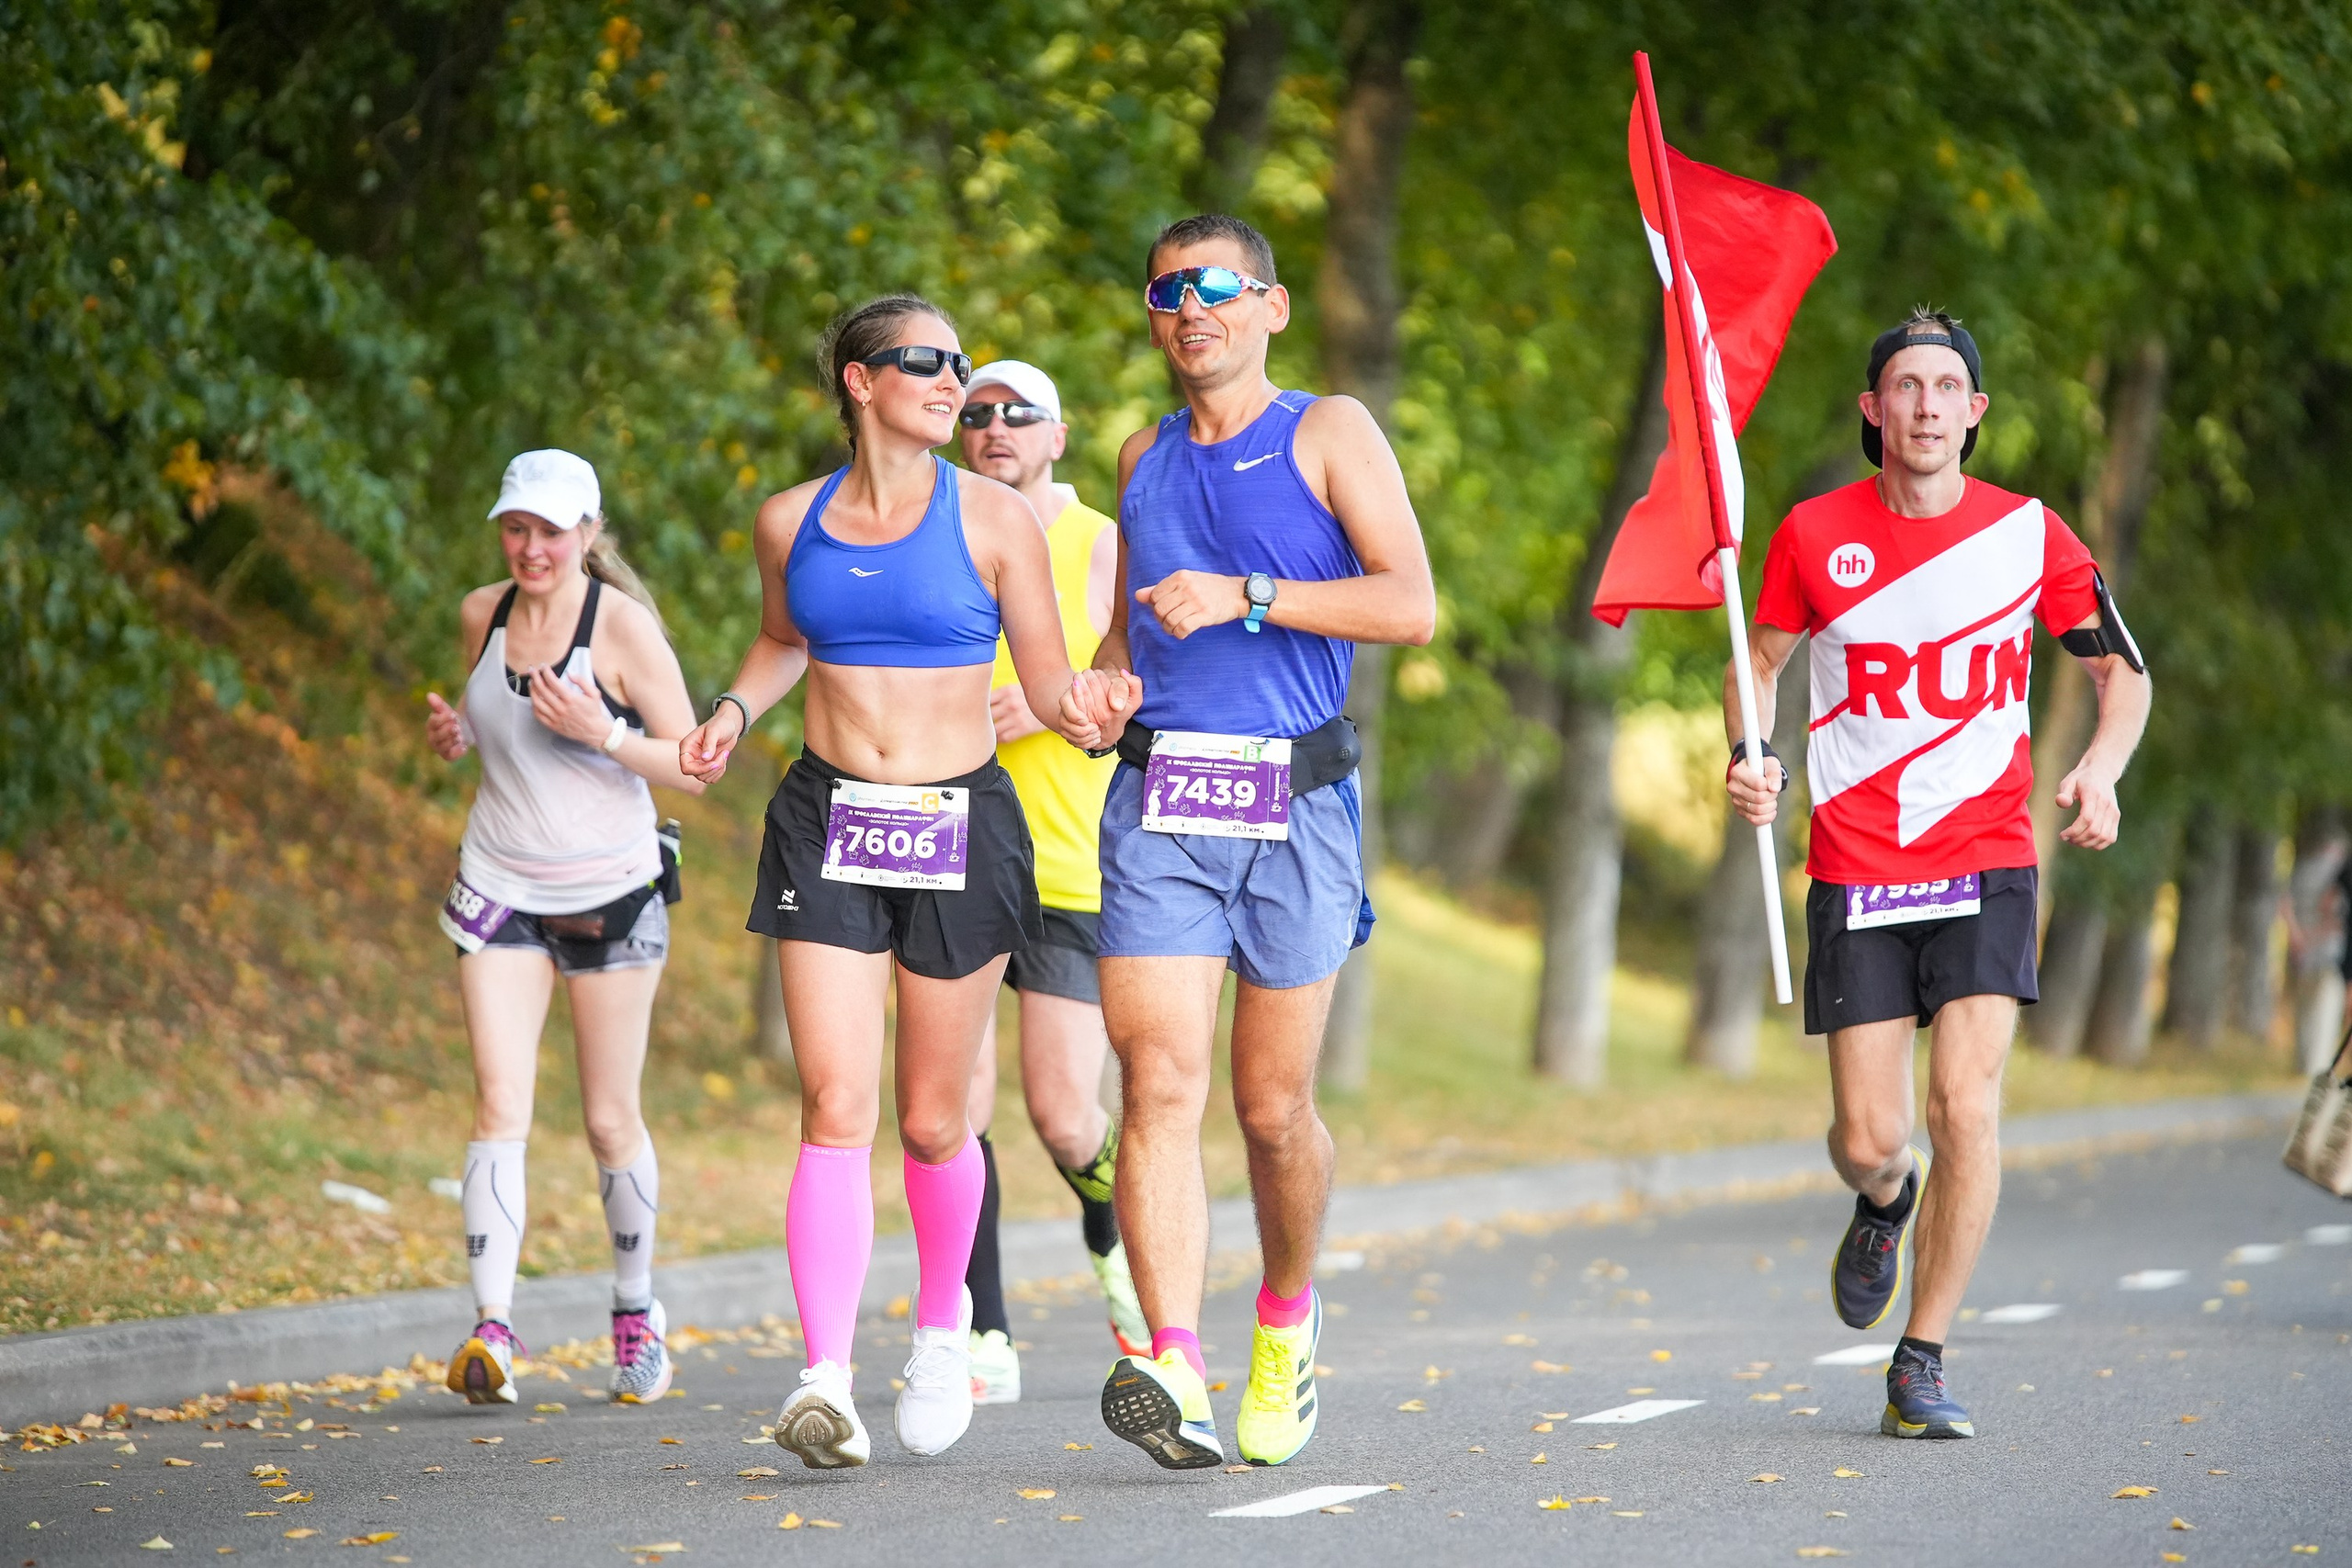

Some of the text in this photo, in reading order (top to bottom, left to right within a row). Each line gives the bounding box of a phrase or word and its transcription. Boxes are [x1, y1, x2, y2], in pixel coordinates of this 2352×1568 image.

[1838, 554, 1866, 574] hh
[1844, 627, 2031, 721] RUN
[1247, 746, 1259, 759] B
[1214, 763, 1256, 772] ПОЛУМАРАФОН
[1167, 774, 1257, 807] 7439
[923, 795, 935, 808] C
[892, 814, 934, 822] ПОЛУМАРАФОН
[845, 825, 937, 859] 7606
[448, 879, 485, 920] 638
